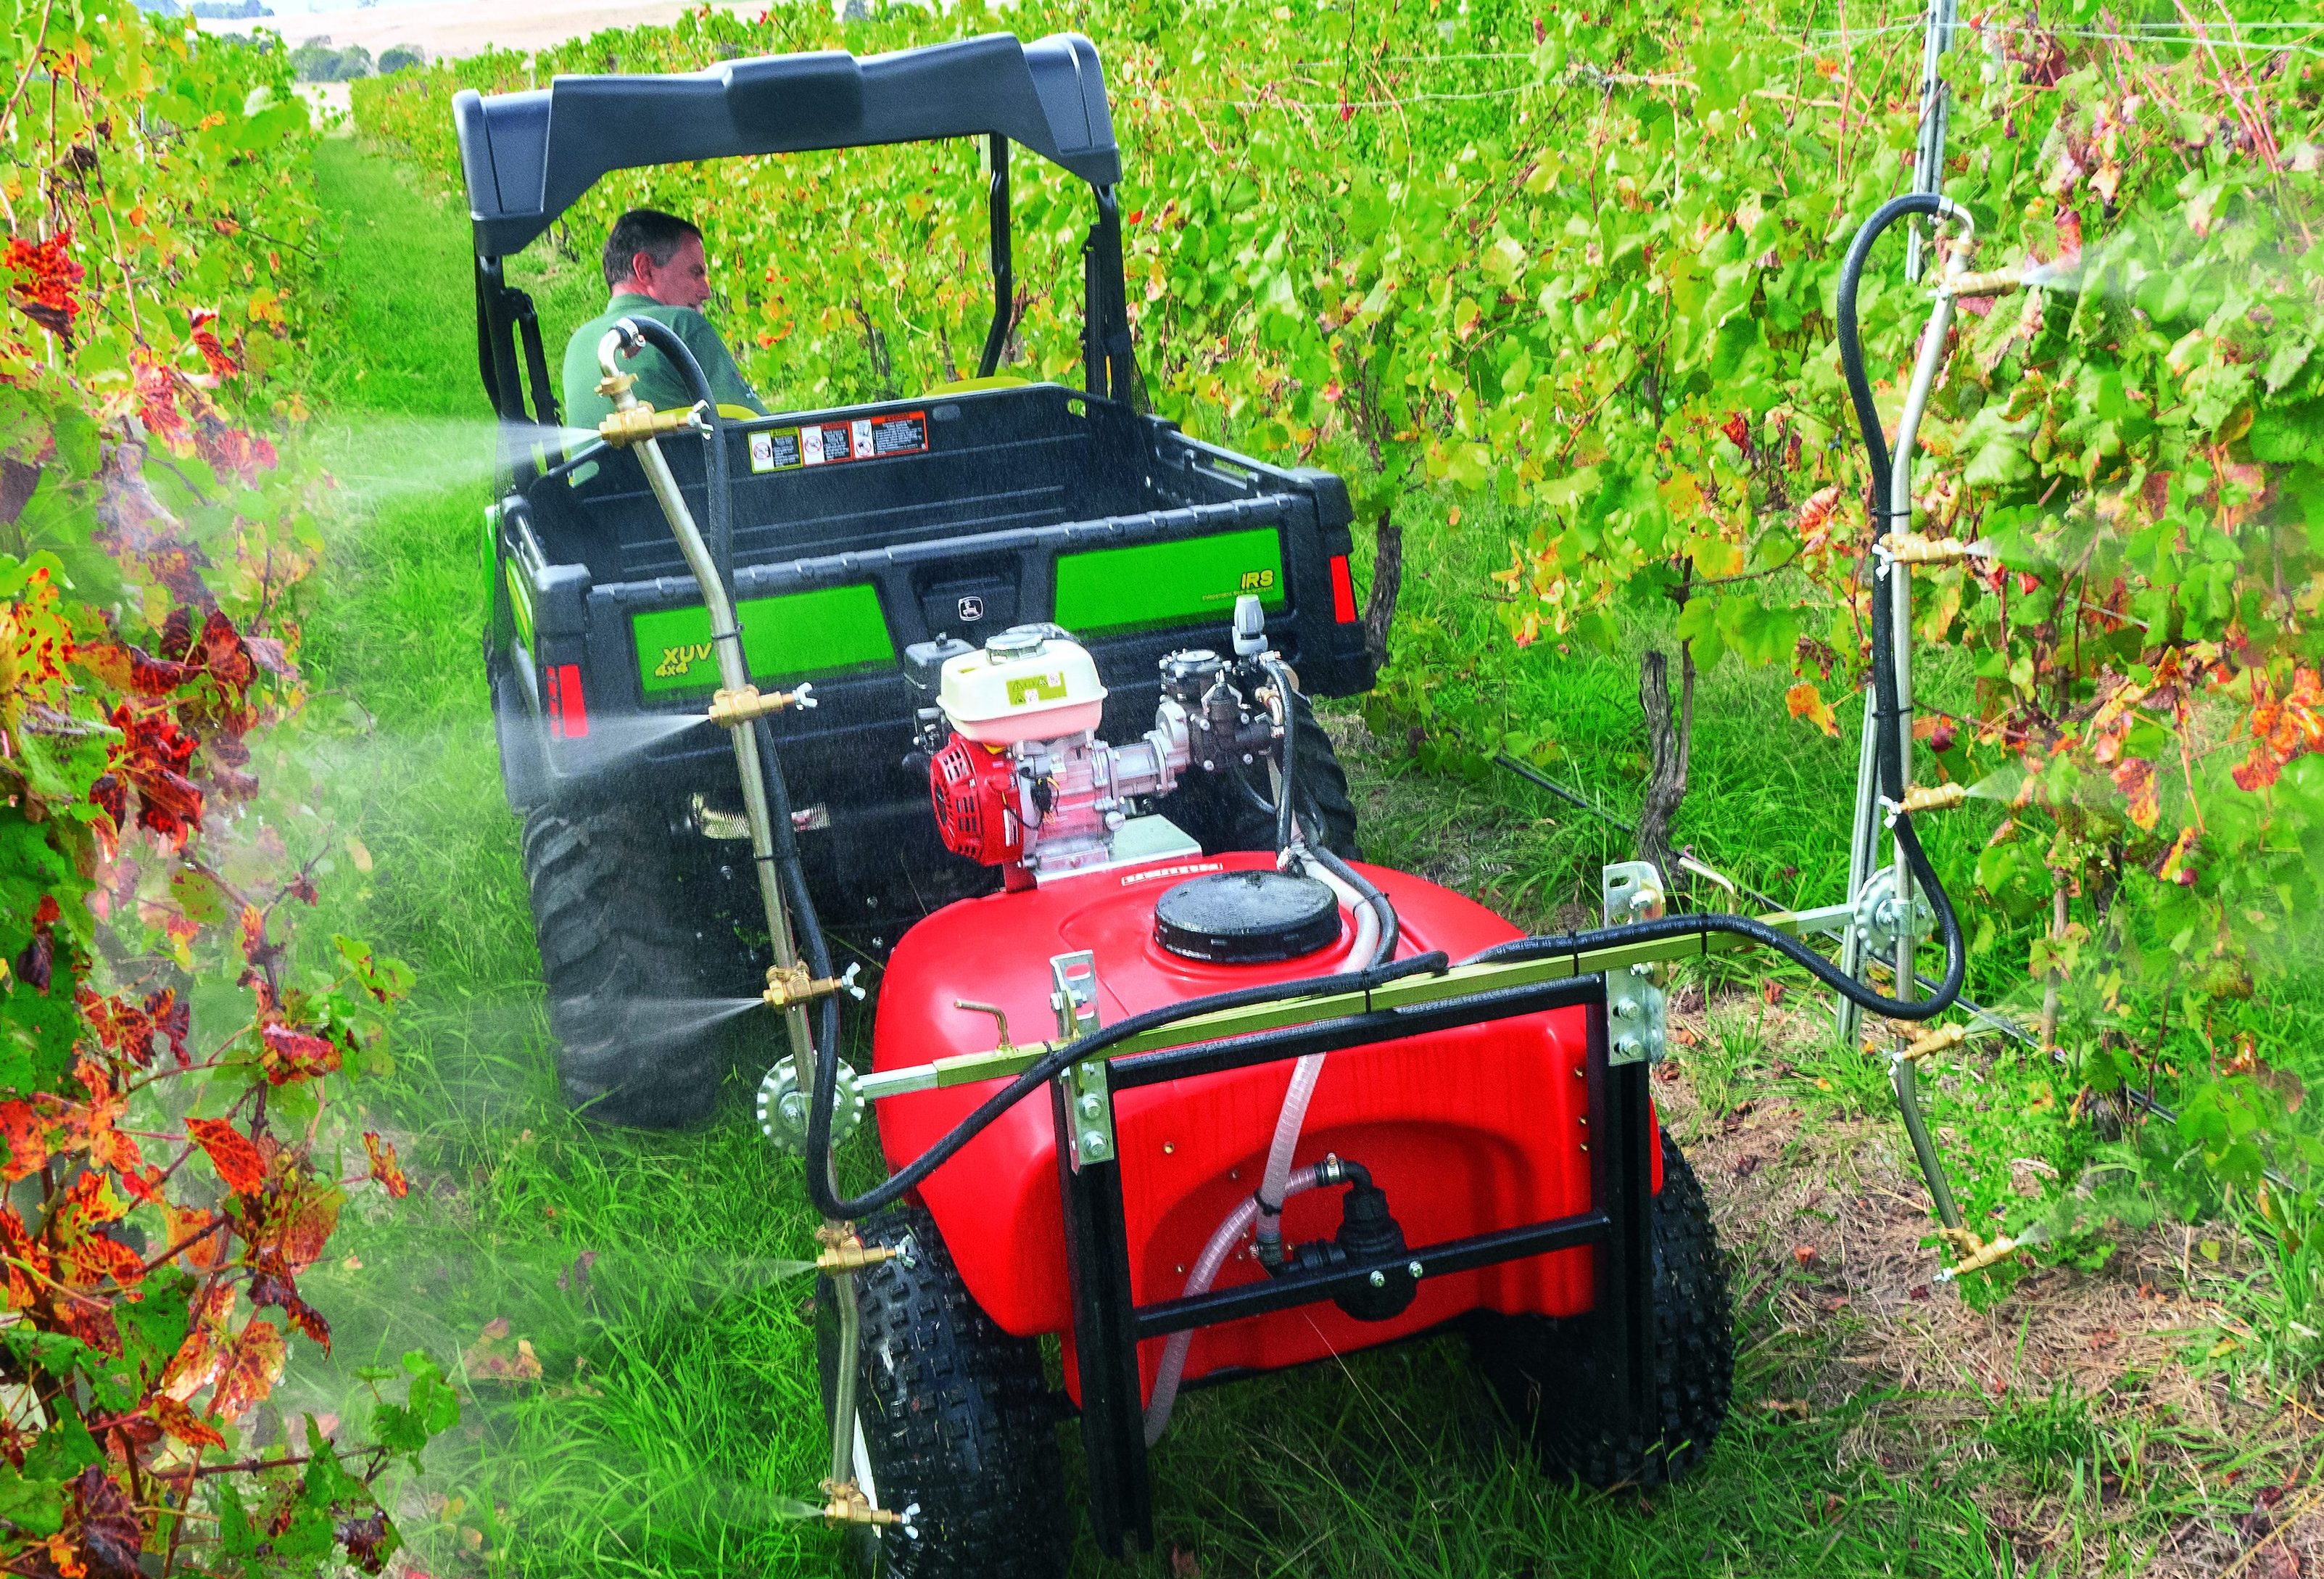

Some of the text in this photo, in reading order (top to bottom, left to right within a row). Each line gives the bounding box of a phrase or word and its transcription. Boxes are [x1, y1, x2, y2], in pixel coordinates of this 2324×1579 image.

[1241, 569, 1273, 590] IRS
[663, 642, 712, 664] XUV
[655, 662, 688, 677] 4x4
